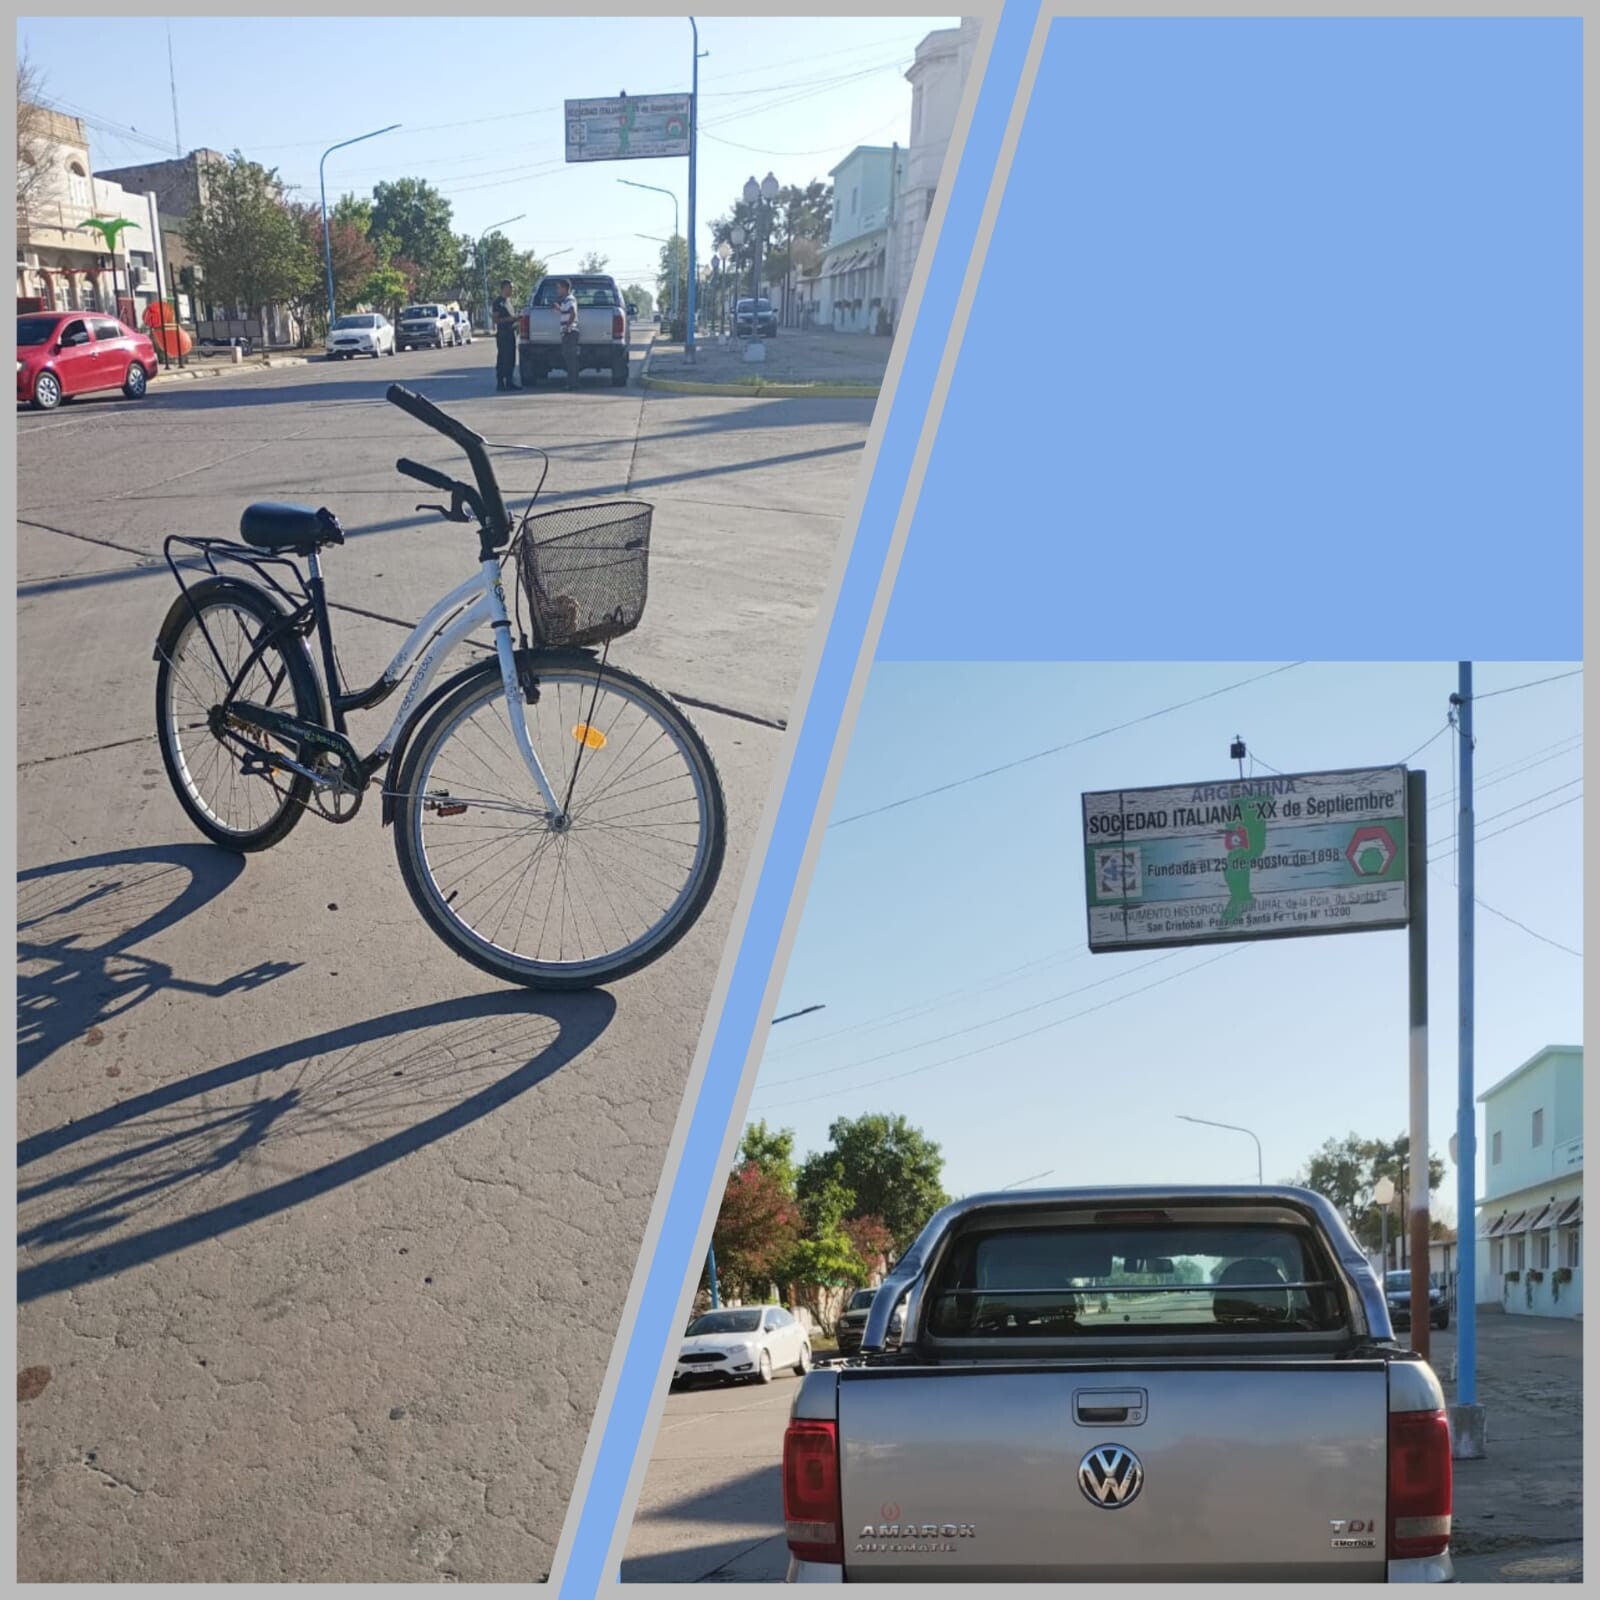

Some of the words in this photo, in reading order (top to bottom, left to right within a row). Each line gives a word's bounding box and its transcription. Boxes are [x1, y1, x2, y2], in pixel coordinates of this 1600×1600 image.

[1192, 780, 1297, 803] ARGENTINA
[1089, 810, 1168, 835] SOCIEDAD
[1173, 804, 1243, 828] ITALIANA
[1283, 799, 1301, 817] de
[1147, 860, 1197, 877] Fundada
[1214, 857, 1229, 873] 25
[1232, 857, 1246, 870] de
[1250, 853, 1289, 871] agosto
[1292, 851, 1307, 867] de
[1312, 847, 1340, 865] 1898
[1110, 904, 1173, 923] MONUMENTO
[1146, 921, 1164, 933] San
[859, 1523, 976, 1539] AMAROK
[1330, 1519, 1375, 1534] TDI
[854, 1542, 957, 1553] AUTOMATIC
